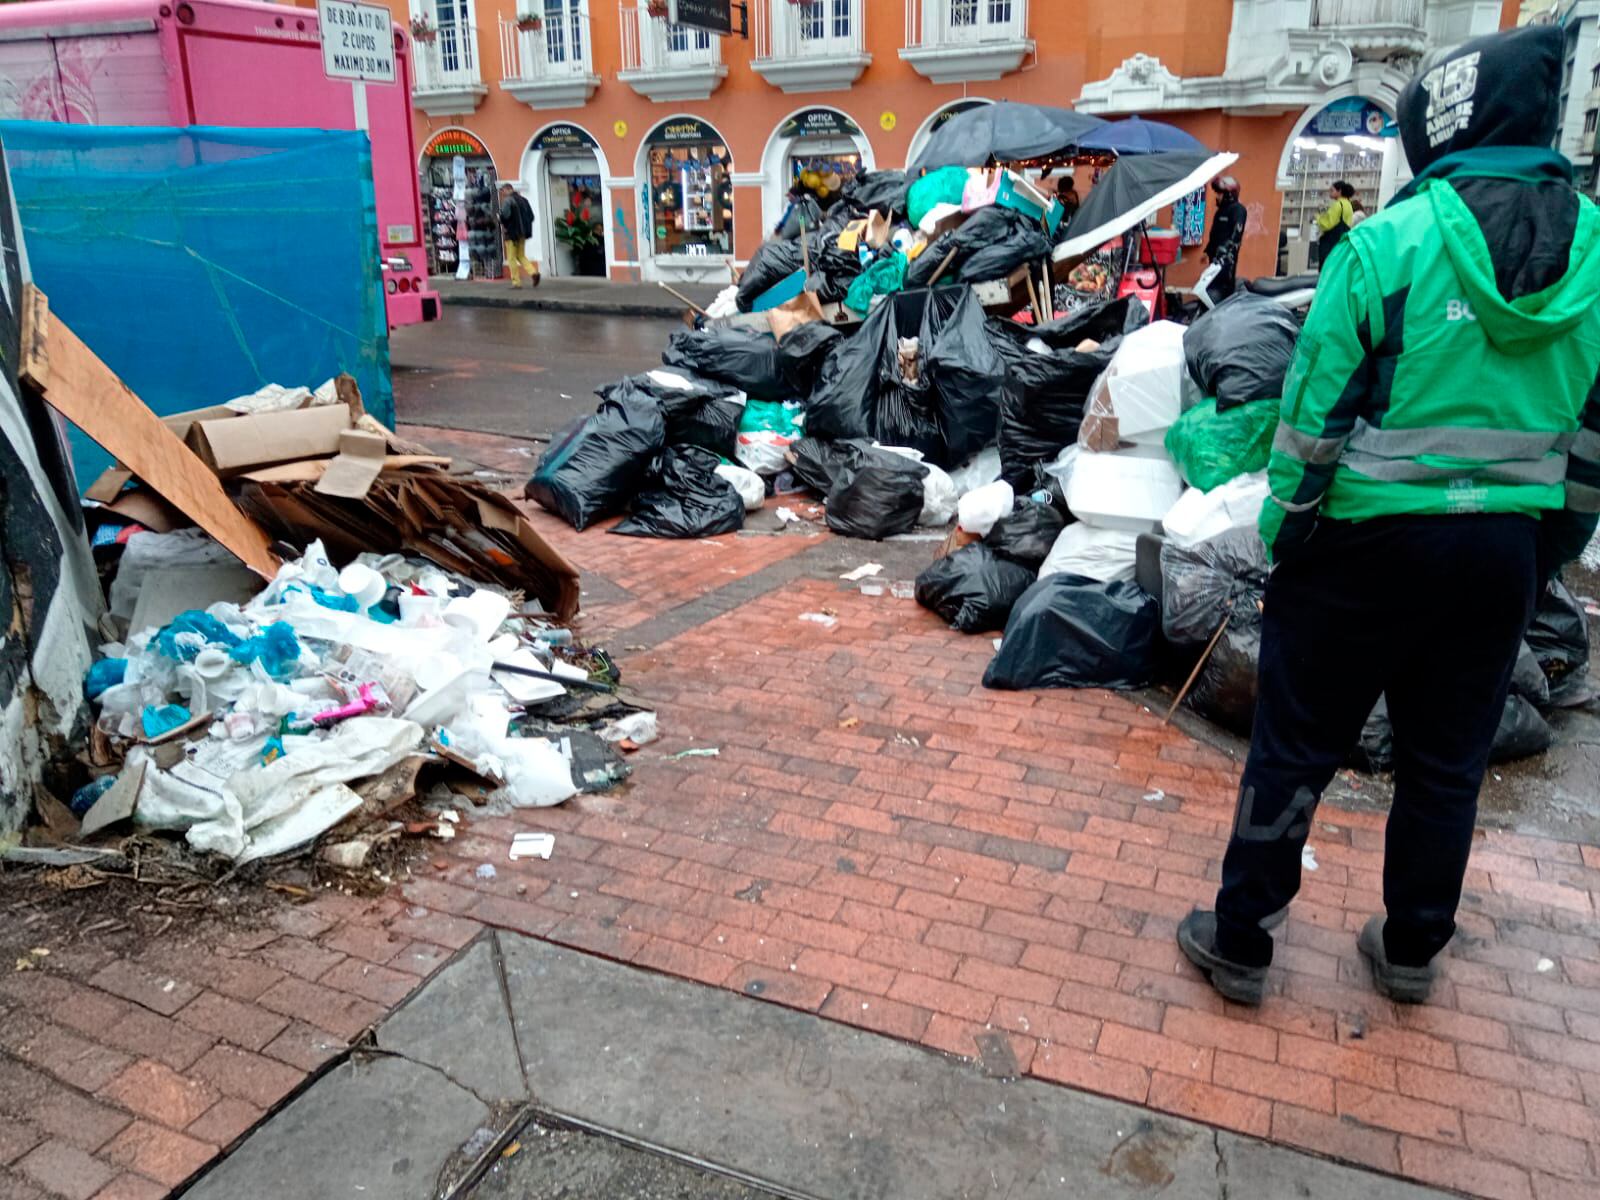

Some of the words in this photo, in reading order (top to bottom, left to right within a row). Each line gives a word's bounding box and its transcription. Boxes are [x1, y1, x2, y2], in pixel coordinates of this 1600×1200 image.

[327, 7, 338, 24] DE
[358, 12, 364, 28] A
[364, 13, 372, 29] 17
[342, 31, 349, 48] 2
[351, 32, 376, 52] CUPOS
[334, 54, 364, 72] MAXIMO
[366, 57, 375, 73] 30
[377, 59, 391, 74] MIN
[807, 113, 833, 122] OPTICA
[551, 127, 571, 136] OPTICA
